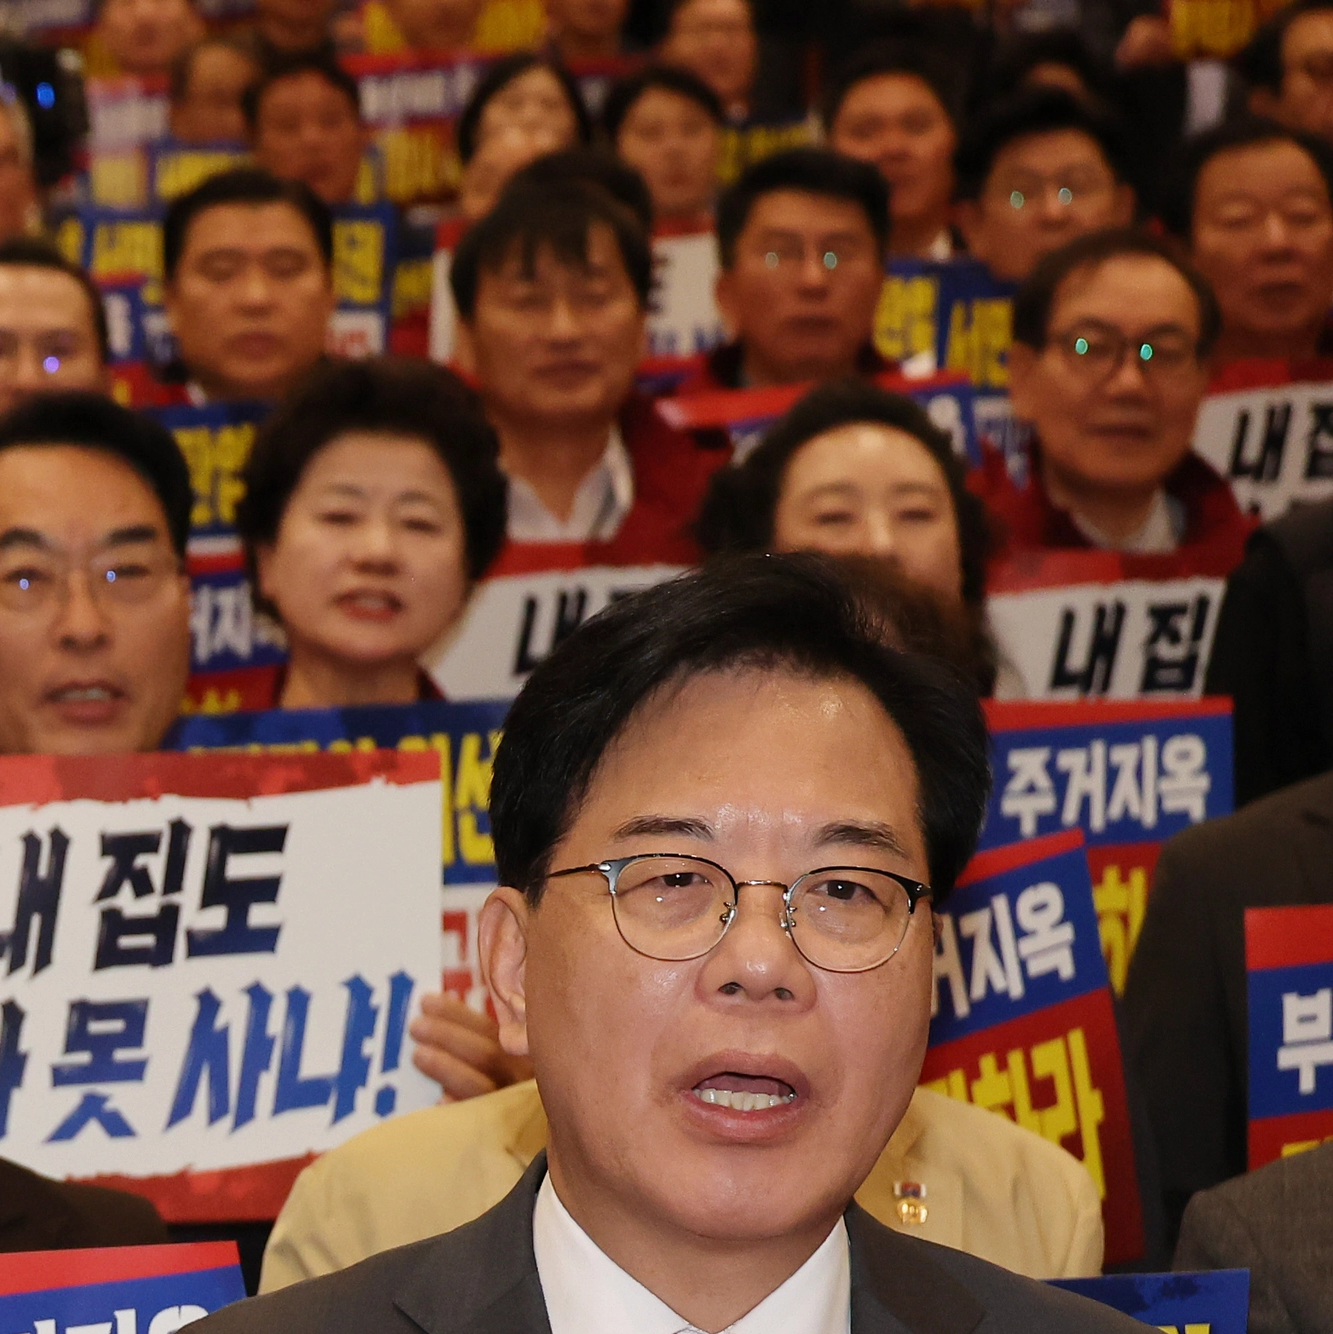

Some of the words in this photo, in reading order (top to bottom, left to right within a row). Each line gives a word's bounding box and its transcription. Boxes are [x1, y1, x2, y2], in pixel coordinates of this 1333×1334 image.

[1140, 594, 1211, 692] 집
[1000, 733, 1211, 838] 주거지옥
[92, 817, 290, 972] 집도
[935, 883, 1075, 1015] 거지옥
[44, 1003, 149, 1143] 못
[166, 969, 417, 1136] 사냐!
